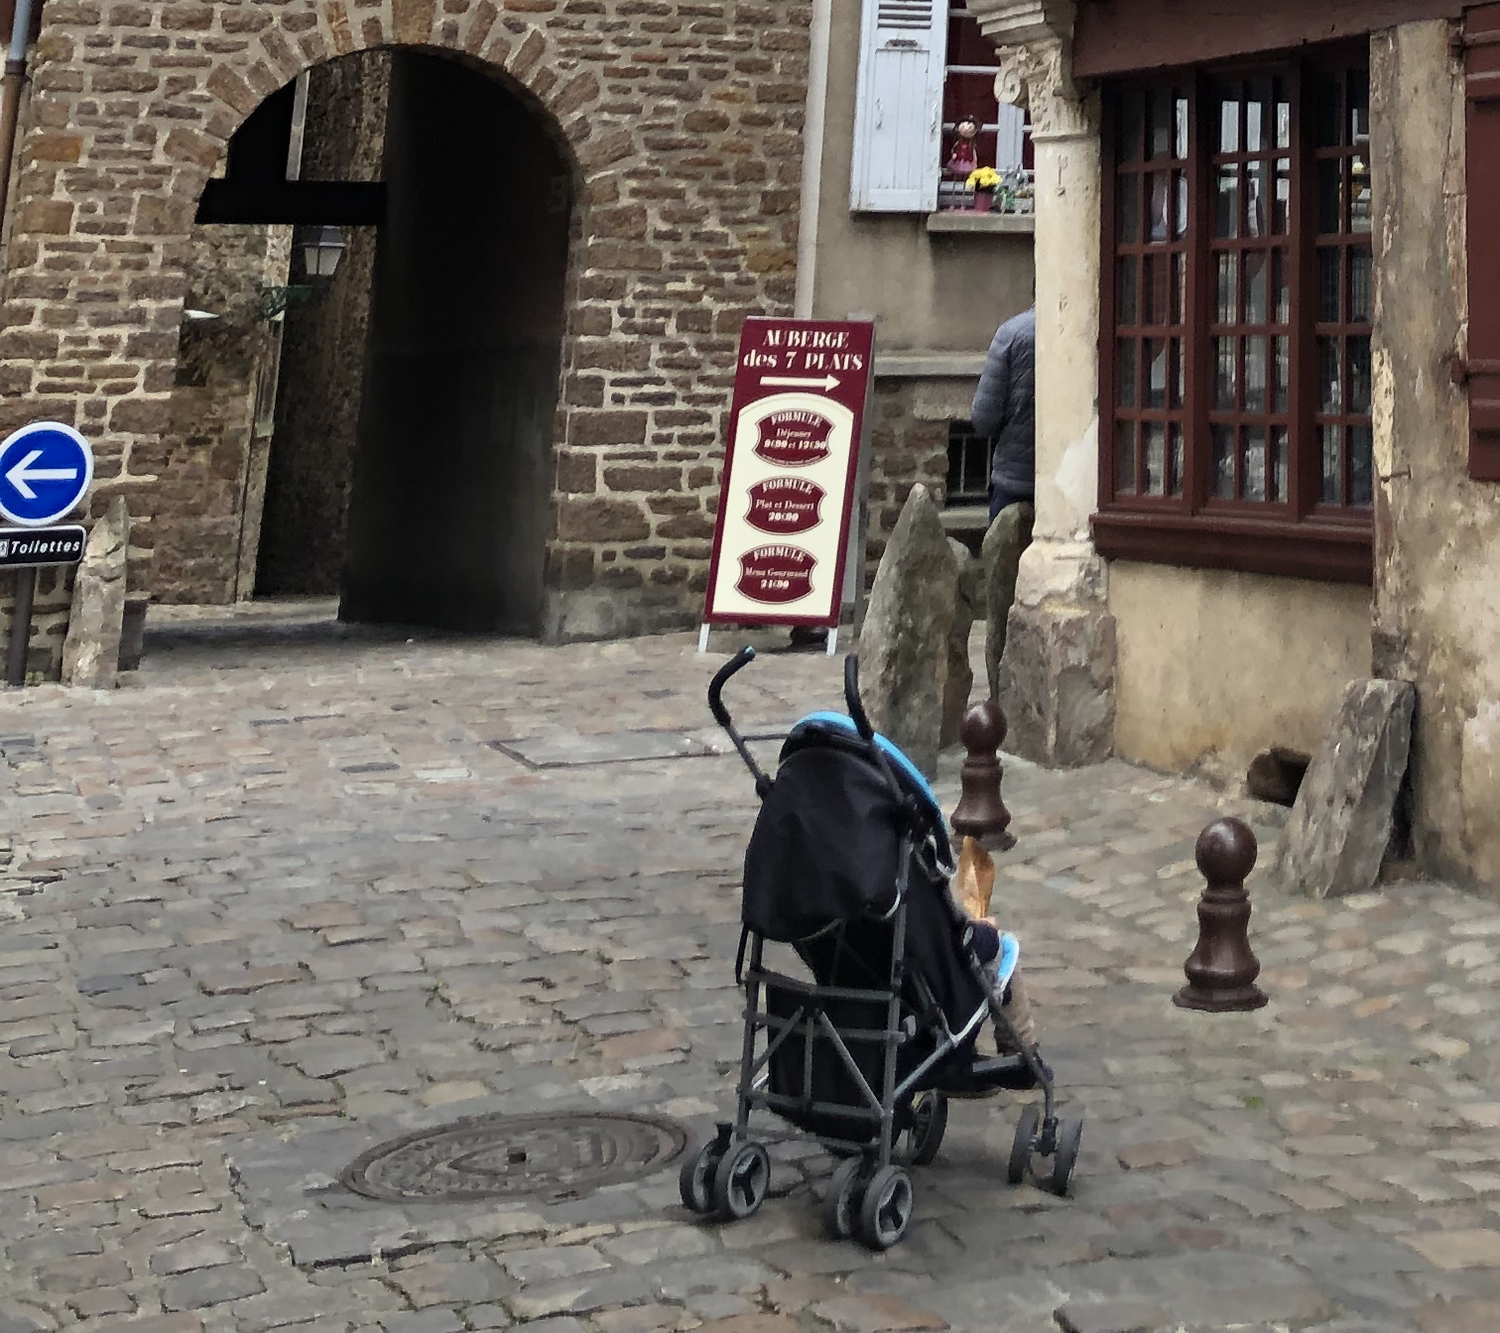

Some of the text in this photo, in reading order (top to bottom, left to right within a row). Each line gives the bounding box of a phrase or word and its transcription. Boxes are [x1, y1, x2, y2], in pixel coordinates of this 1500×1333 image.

[762, 328, 850, 349] AUBERGE
[743, 348, 864, 371] des 7 PLATS
[771, 410, 824, 428] FORMULE
[762, 478, 815, 495] FORMULE
[755, 498, 815, 511] Plat et Dessert
[10, 539, 81, 555] Toilettes
[753, 545, 807, 563] FORMULE
[745, 566, 767, 577] Menu
